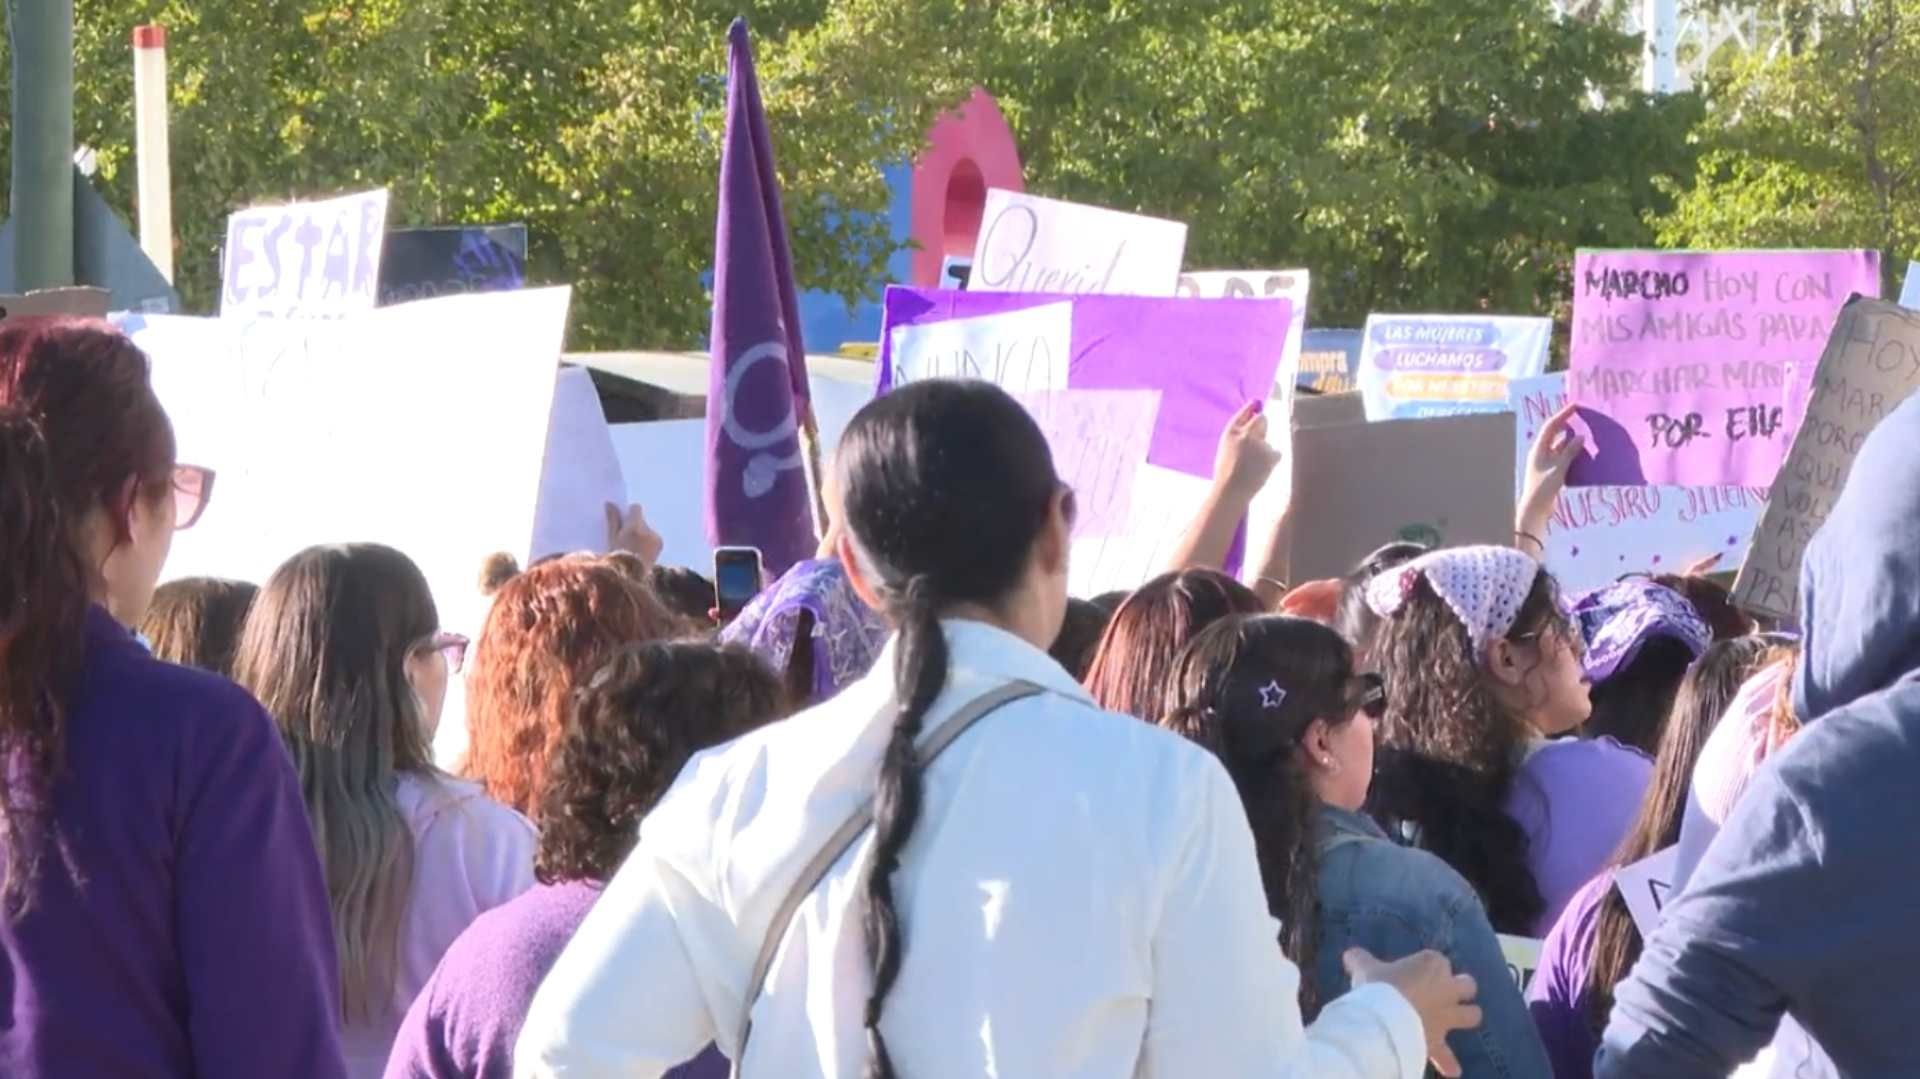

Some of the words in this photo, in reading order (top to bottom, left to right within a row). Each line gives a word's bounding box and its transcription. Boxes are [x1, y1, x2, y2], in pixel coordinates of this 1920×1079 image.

[225, 200, 381, 305] ESTAR
[980, 203, 1137, 298] Querid
[1776, 270, 1834, 303] CON
[1384, 327, 1411, 340] LAS
[1414, 327, 1486, 342] MUJERES
[1396, 352, 1485, 369] LUCHAMOS
[1645, 409, 1712, 449] POR
